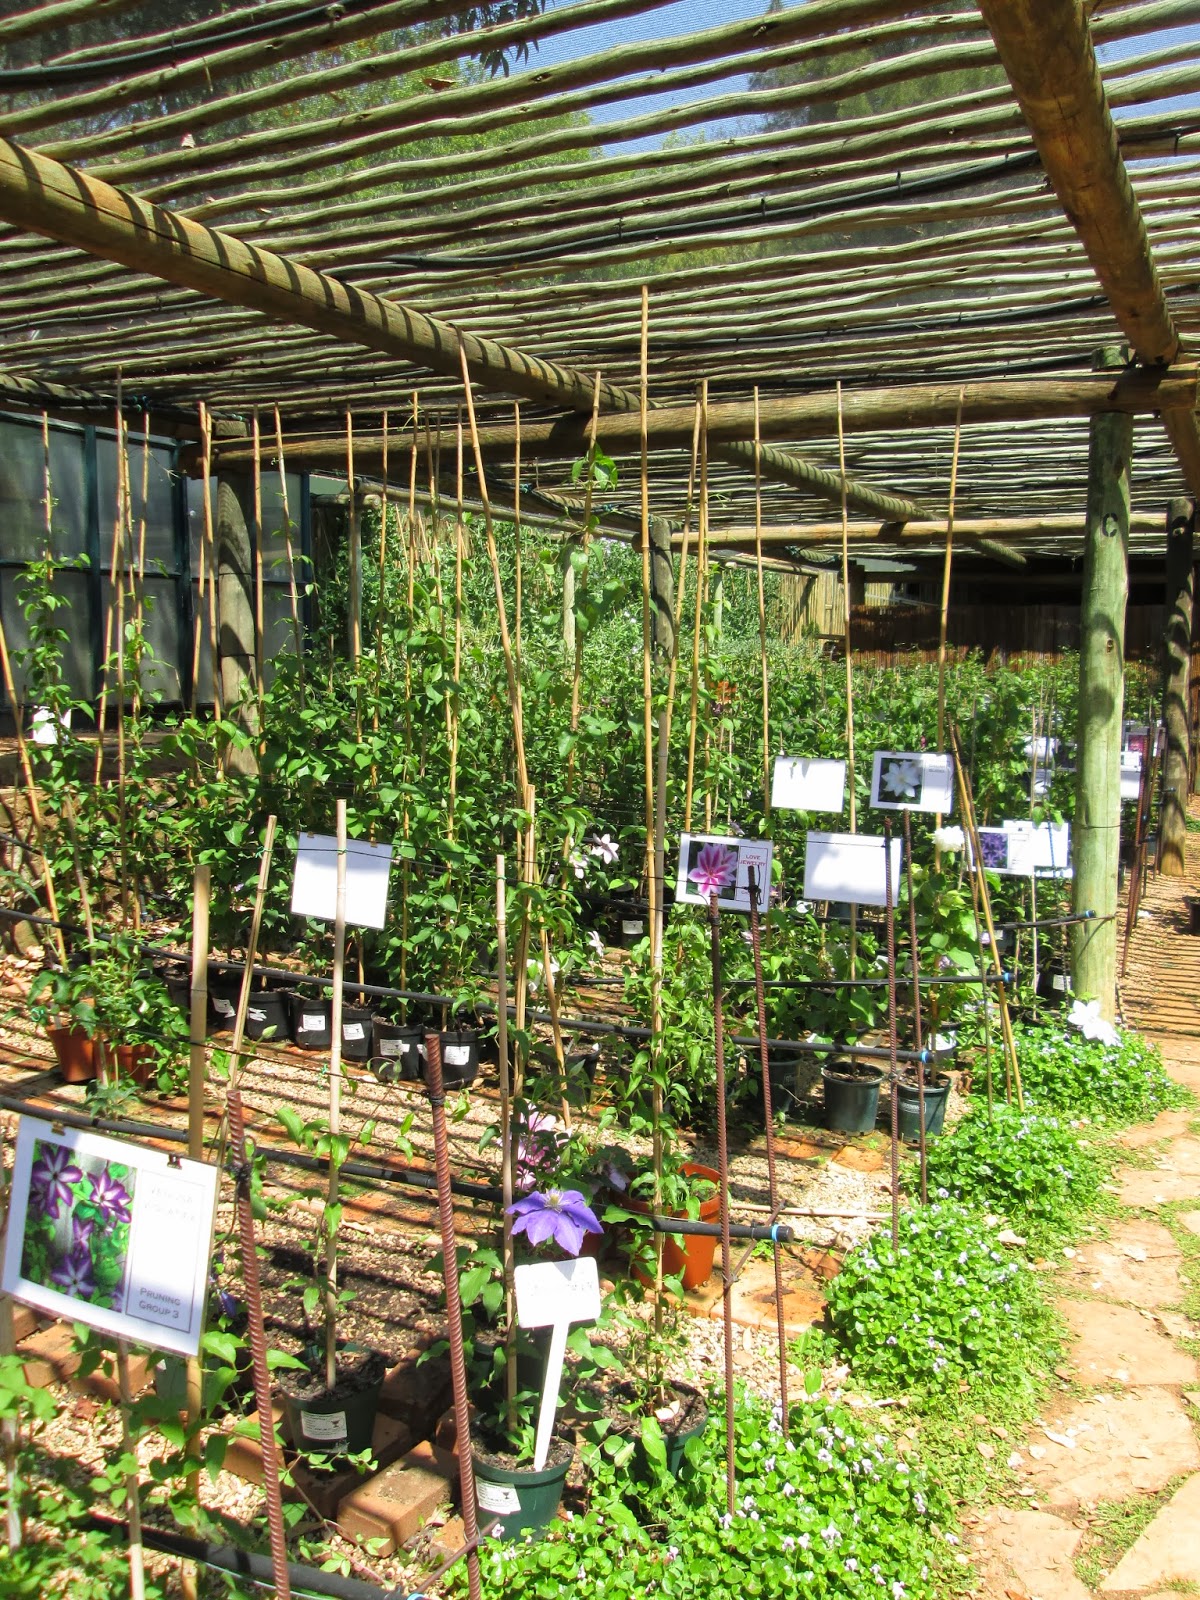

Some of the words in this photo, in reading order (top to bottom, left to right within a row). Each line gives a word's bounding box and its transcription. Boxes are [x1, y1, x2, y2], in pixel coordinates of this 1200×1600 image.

[140, 1287, 180, 1306] PRUNING
[138, 1300, 171, 1315] GROUP
[172, 1310, 179, 1318] 3
